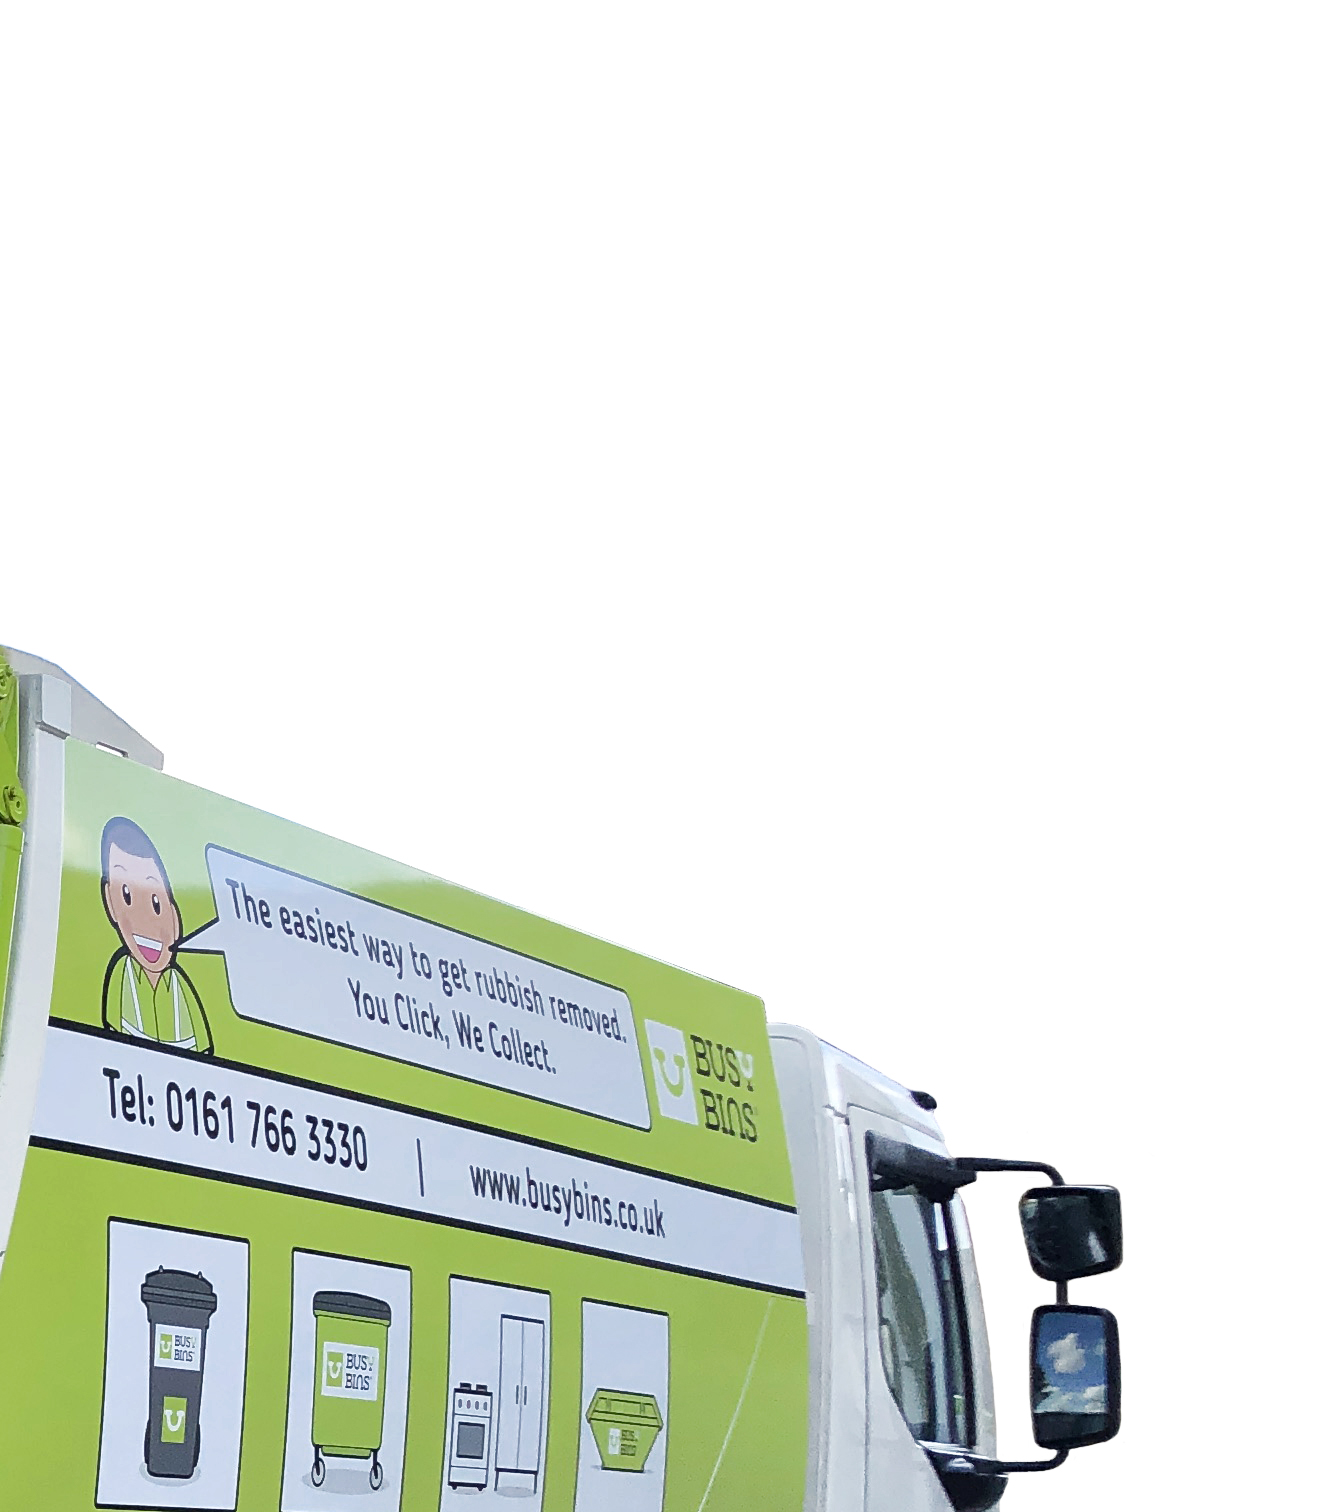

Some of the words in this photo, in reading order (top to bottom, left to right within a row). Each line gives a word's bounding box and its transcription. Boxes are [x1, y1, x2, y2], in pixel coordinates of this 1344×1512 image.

[225, 877, 273, 929] The
[278, 906, 359, 957] easiest
[363, 932, 403, 980] way
[409, 941, 432, 980] to
[438, 957, 472, 997] get
[474, 970, 545, 1017] rubbish
[548, 993, 628, 1044] removed.
[347, 977, 389, 1026] You
[394, 992, 451, 1050] Click,
[452, 1009, 484, 1052] We
[488, 1020, 558, 1075] Collect.
[102, 1067, 155, 1127] Tel:
[166, 1081, 235, 1144] 0161
[246, 1100, 297, 1156] 766
[305, 1114, 368, 1172] 3330
[469, 1164, 667, 1239] www.busybins.co.uk
